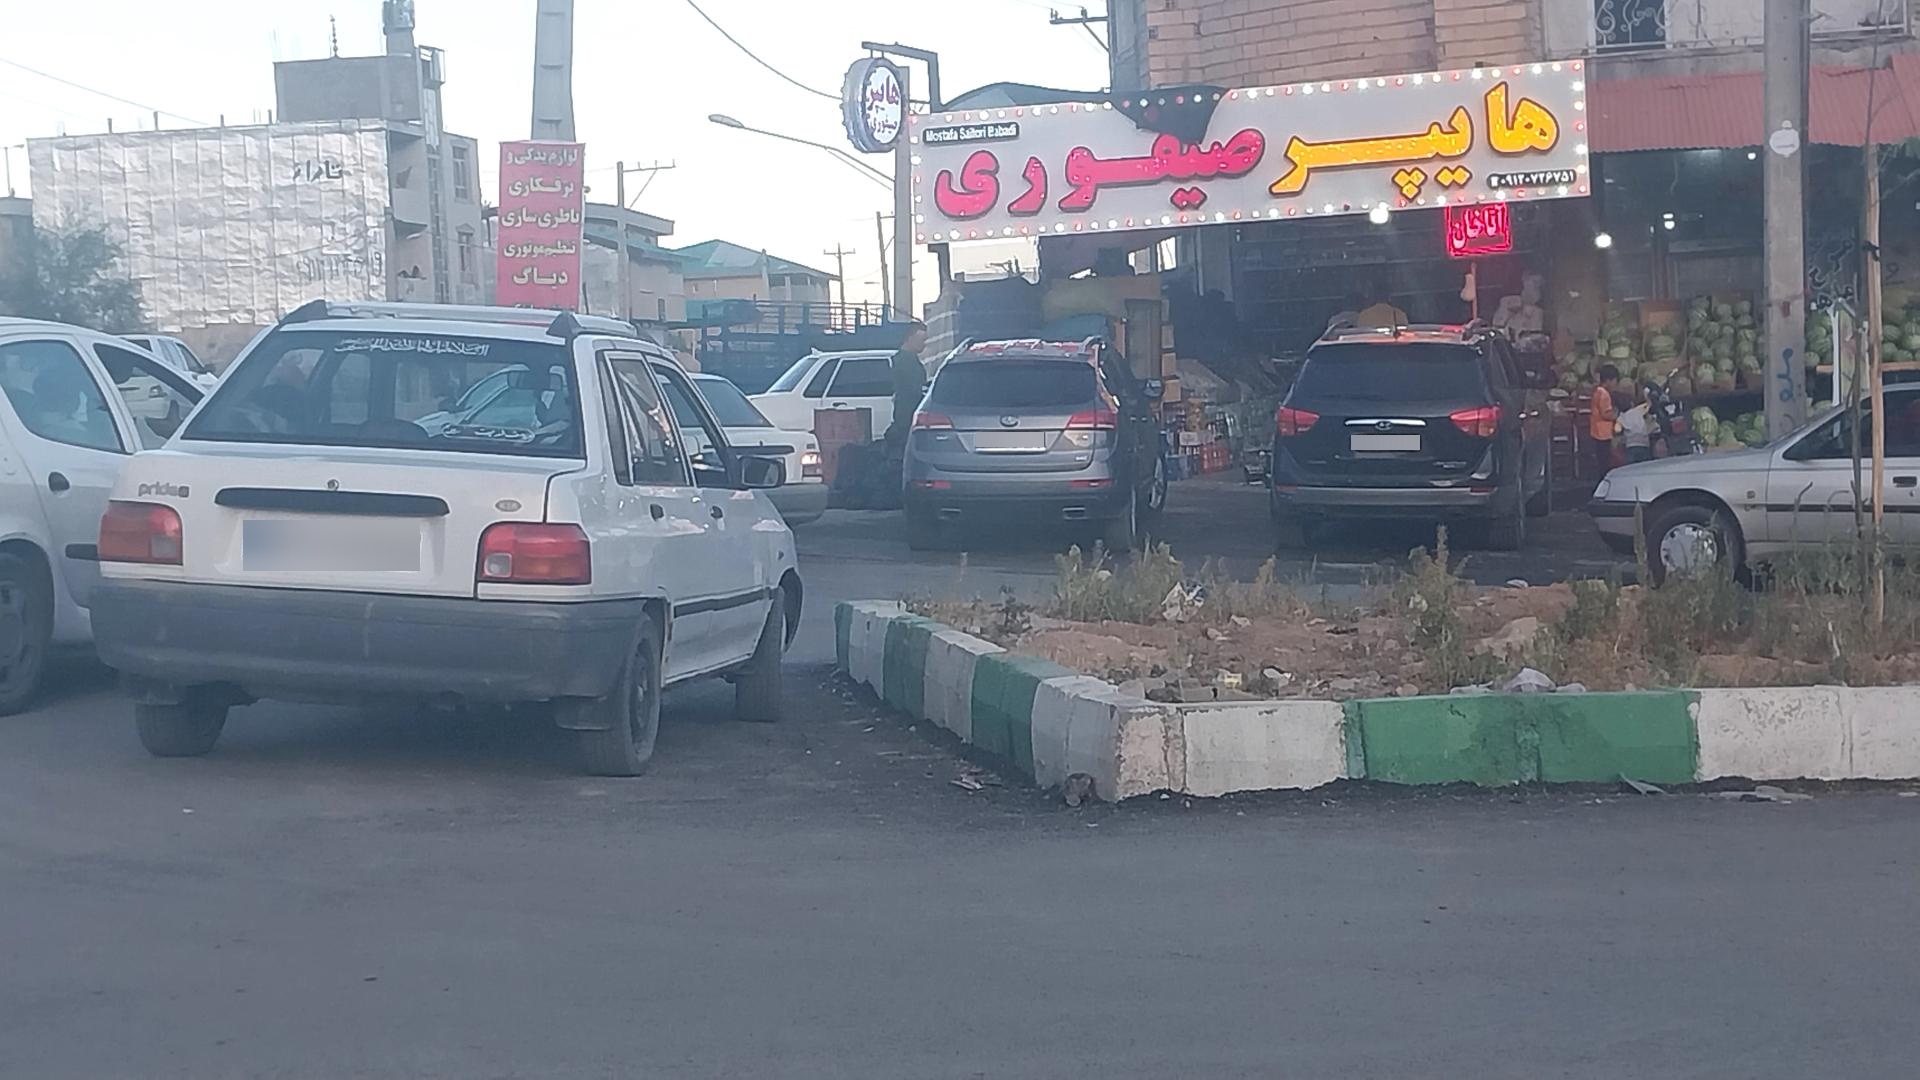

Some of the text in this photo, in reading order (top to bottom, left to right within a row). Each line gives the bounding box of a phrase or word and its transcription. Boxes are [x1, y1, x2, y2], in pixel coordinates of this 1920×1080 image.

[925, 128, 958, 142] Mostafa
[1268, 81, 1560, 199] هایپر
[506, 147, 579, 167] لوازم یدکی و
[512, 266, 569, 289] دیاگ
